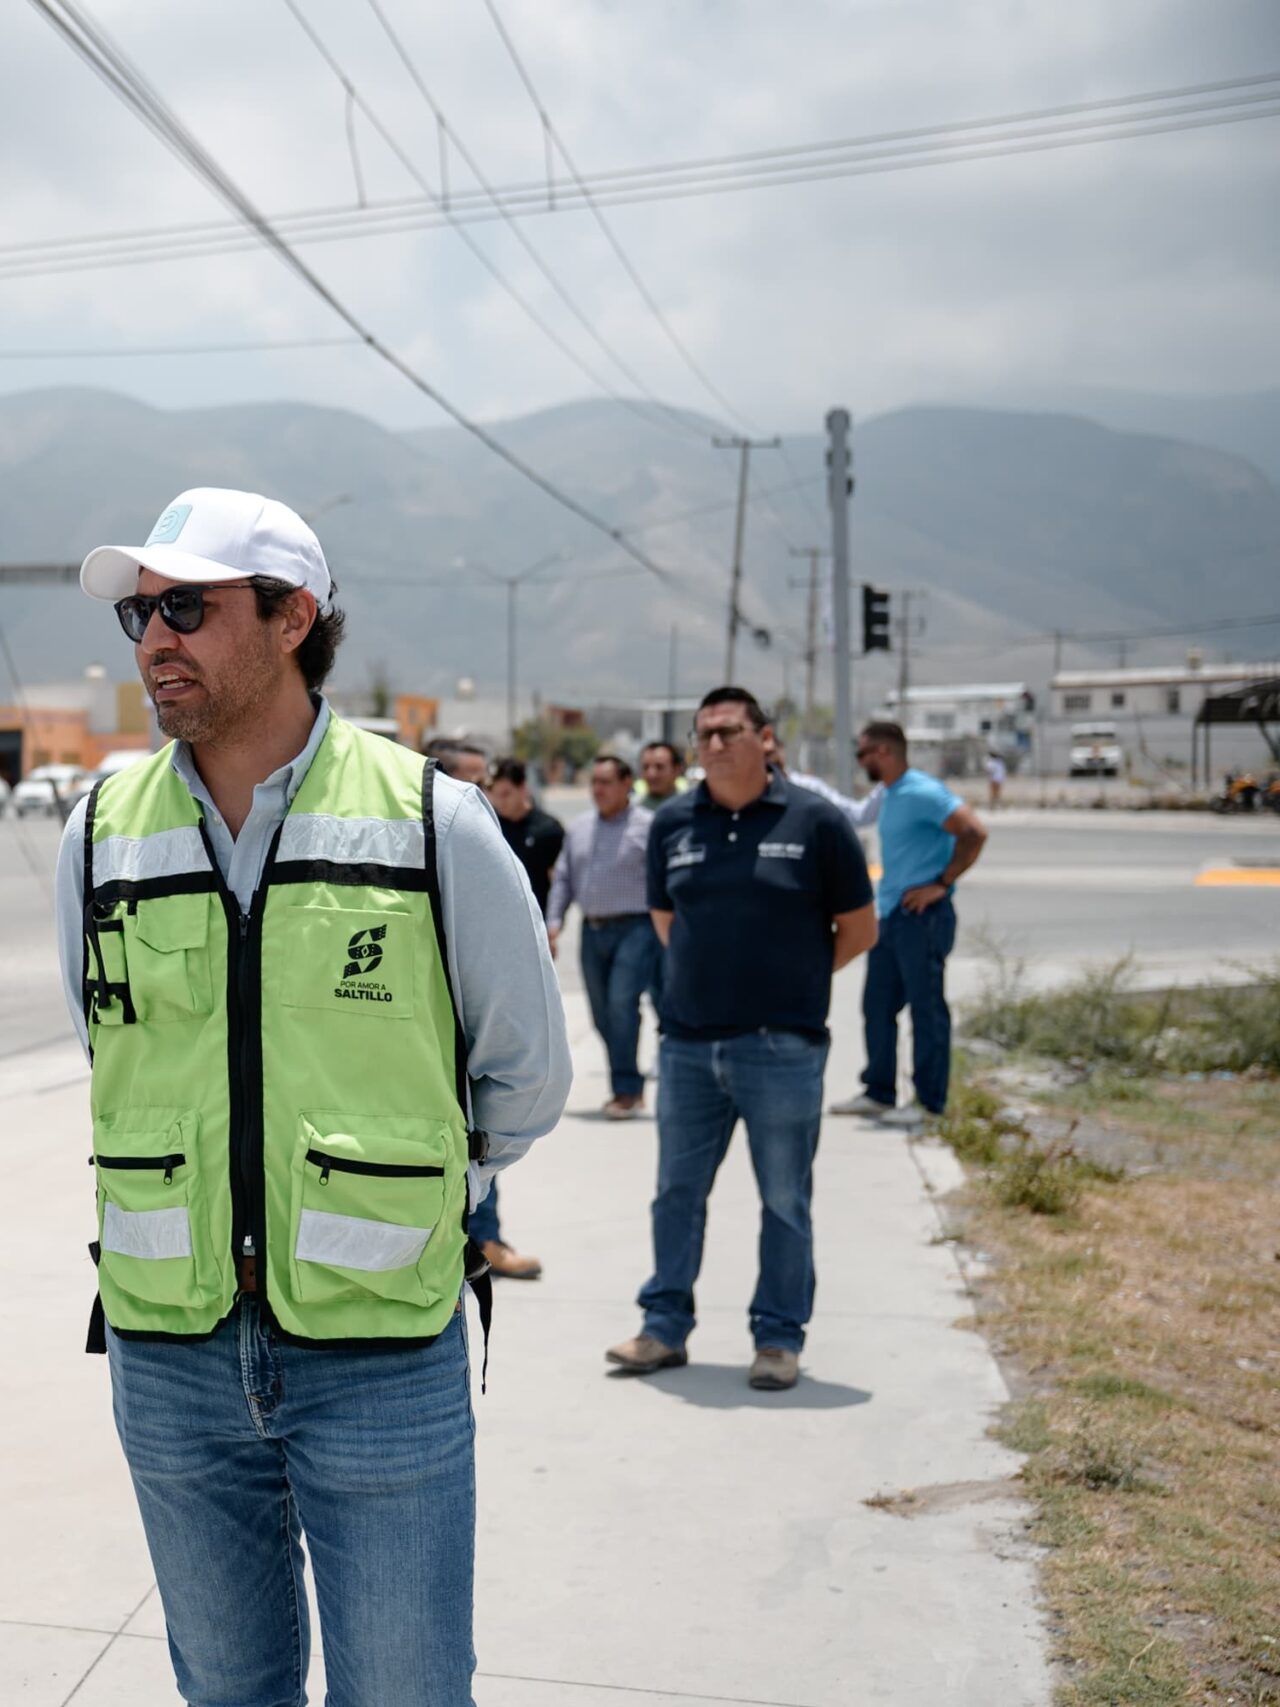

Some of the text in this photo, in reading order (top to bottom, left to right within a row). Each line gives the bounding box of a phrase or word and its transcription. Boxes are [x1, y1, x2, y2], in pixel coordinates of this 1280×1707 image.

[340, 980, 356, 989] POR
[357, 981, 380, 990] AMOR
[334, 988, 393, 1002] SALTILLO
